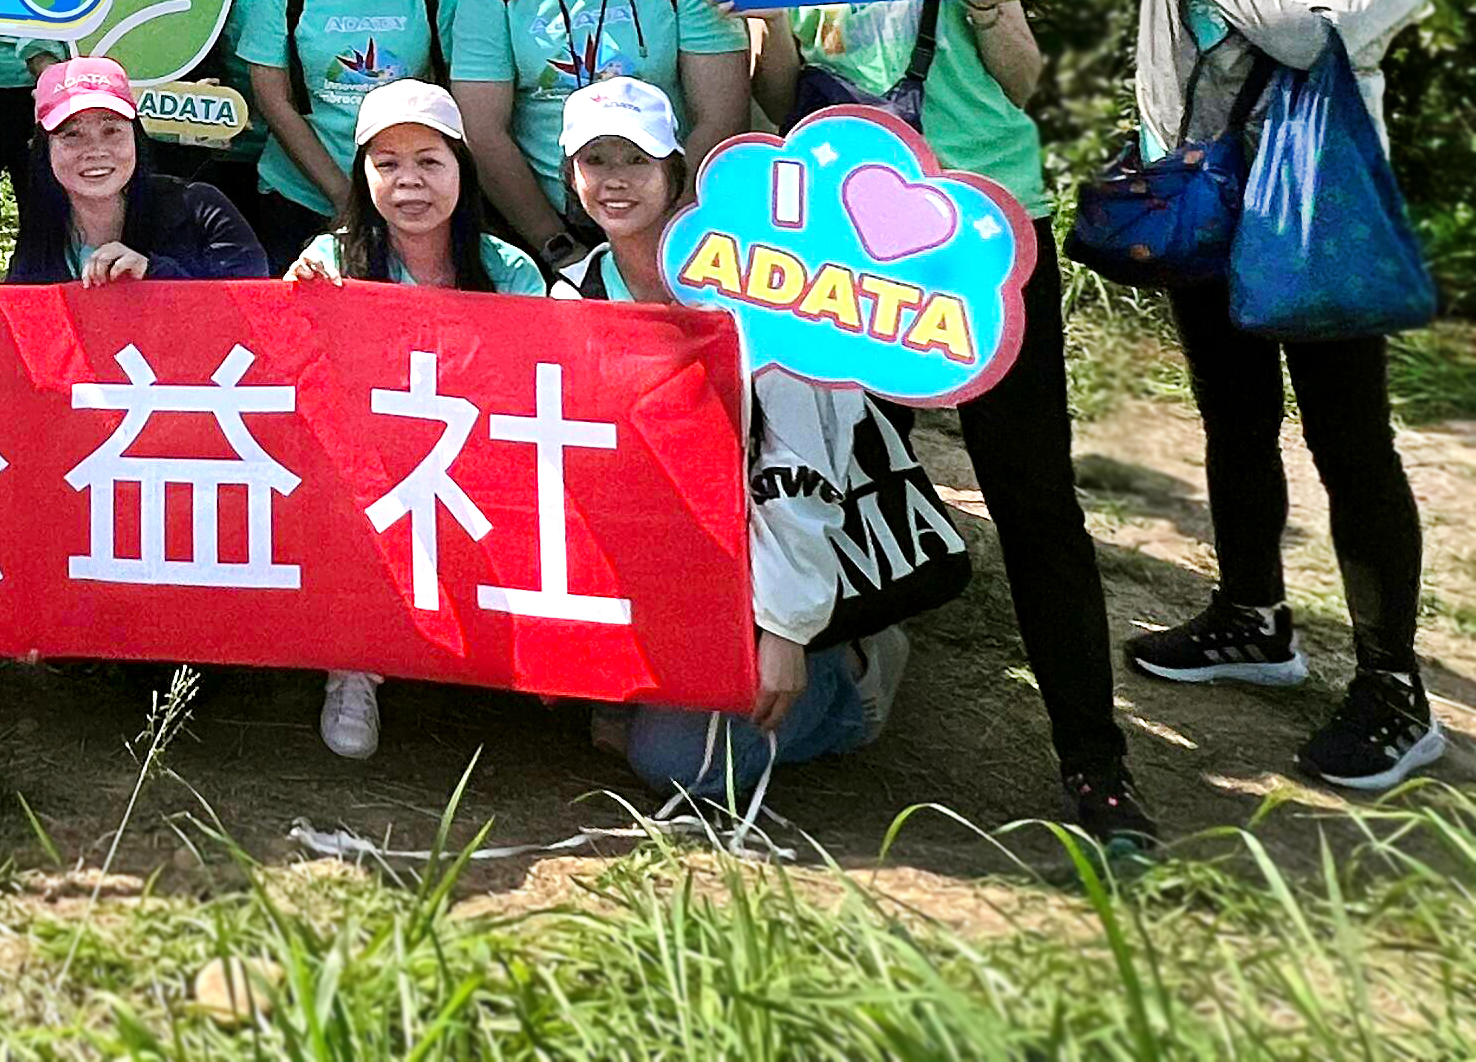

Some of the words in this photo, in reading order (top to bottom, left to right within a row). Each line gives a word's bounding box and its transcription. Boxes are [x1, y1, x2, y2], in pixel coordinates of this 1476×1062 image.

[53, 73, 111, 94] ADATA
[139, 92, 235, 123] ADATA
[772, 160, 805, 228] I
[677, 232, 976, 365] ADATA
